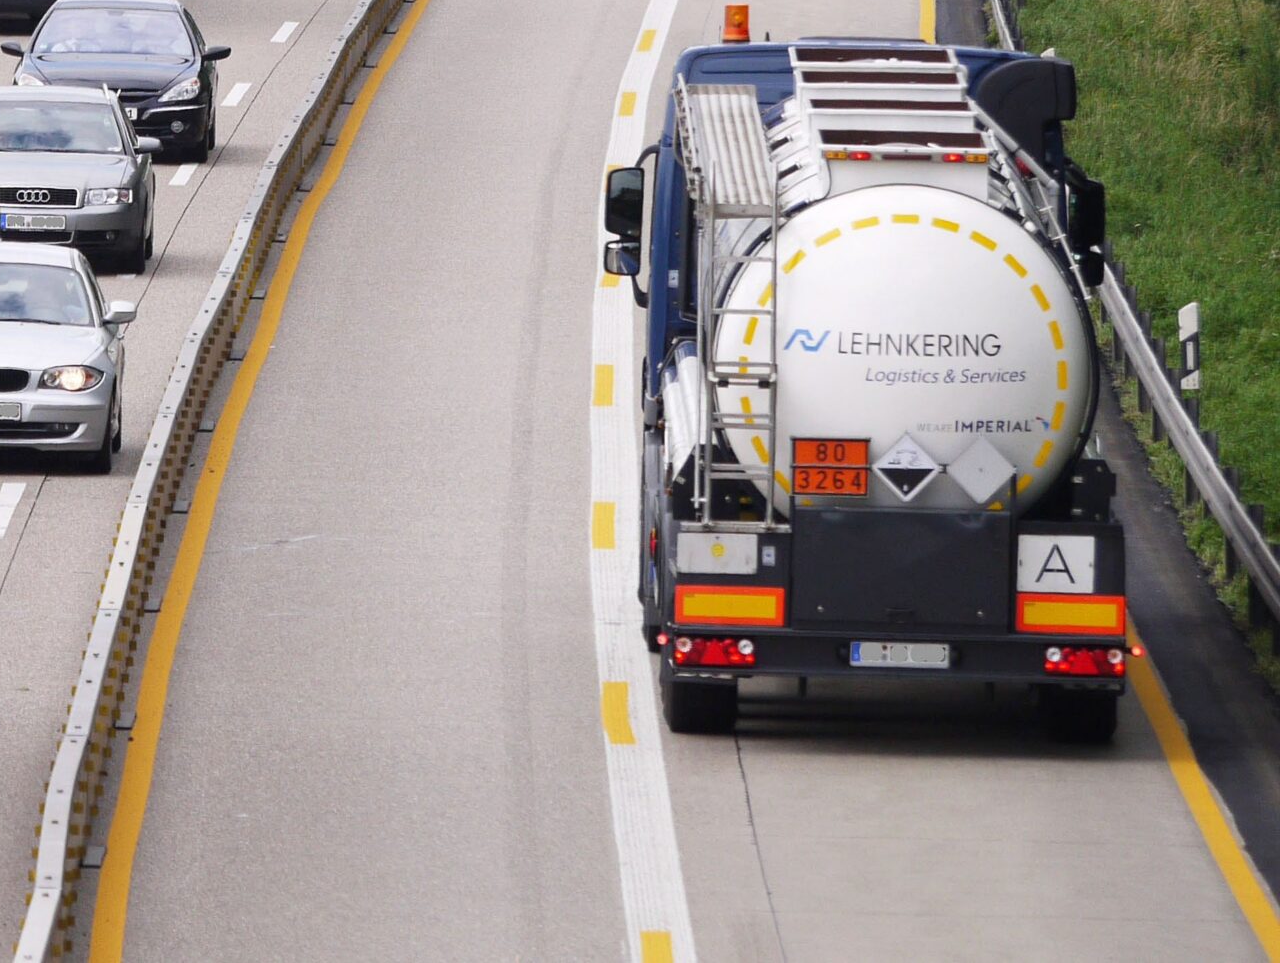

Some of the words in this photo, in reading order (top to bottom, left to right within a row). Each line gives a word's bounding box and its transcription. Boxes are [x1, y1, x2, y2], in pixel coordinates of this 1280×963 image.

[837, 332, 1002, 357] LEHNKERING
[865, 367, 939, 386] Logistics
[943, 369, 956, 383] &
[960, 368, 1027, 384] Services
[955, 420, 1032, 433] IMPERIAL
[815, 443, 845, 462] 80
[798, 470, 862, 490] 3264
[1035, 544, 1076, 584] A
